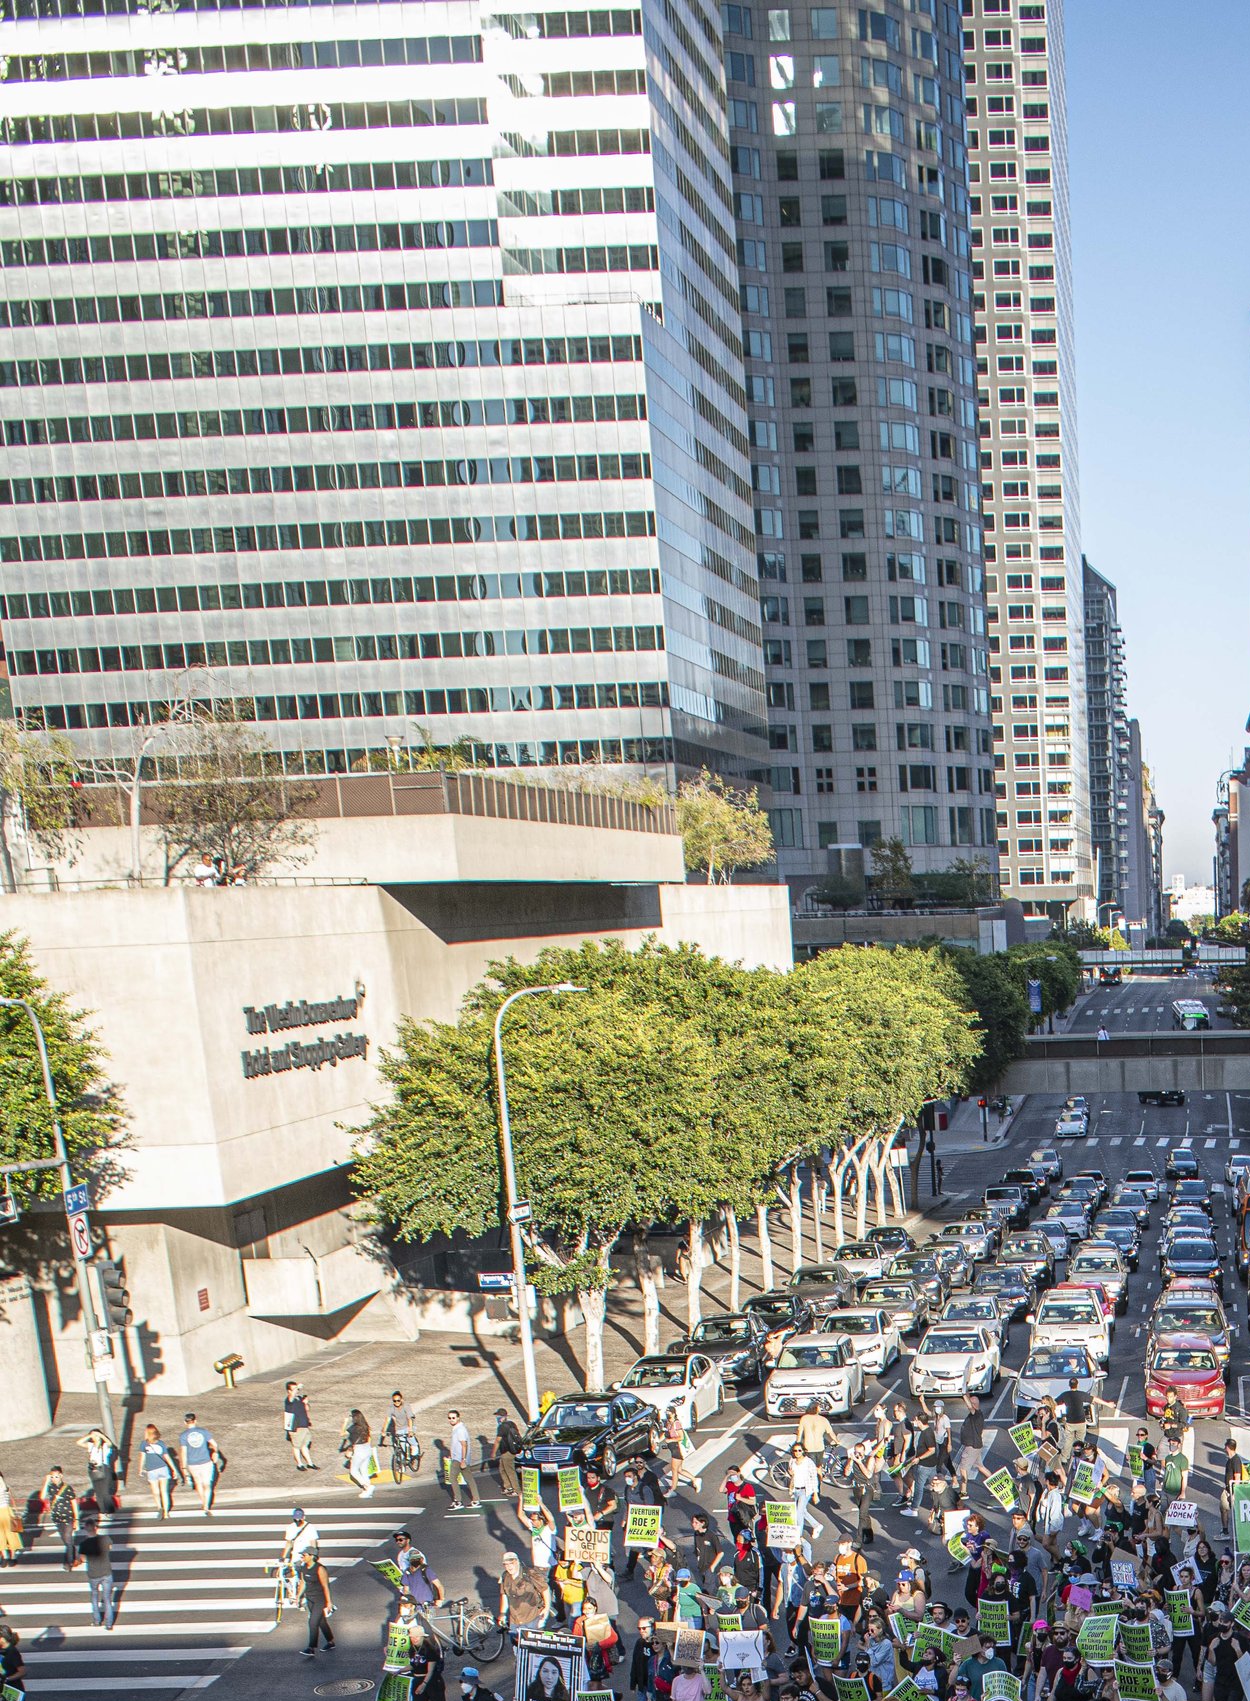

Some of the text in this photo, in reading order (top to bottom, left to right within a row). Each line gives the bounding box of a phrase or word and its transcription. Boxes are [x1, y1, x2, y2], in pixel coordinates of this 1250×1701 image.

[241, 1046, 272, 1079] Hotel
[271, 1043, 292, 1073] and
[290, 1037, 337, 1072] Shopping
[66, 1190, 87, 1211] 5th St
[630, 1508, 660, 1516] OVERTURN
[632, 1518, 648, 1527] ROE
[628, 1527, 644, 1535] HELL
[570, 1529, 609, 1543] SCOTUS
[581, 1542, 596, 1550] GET
